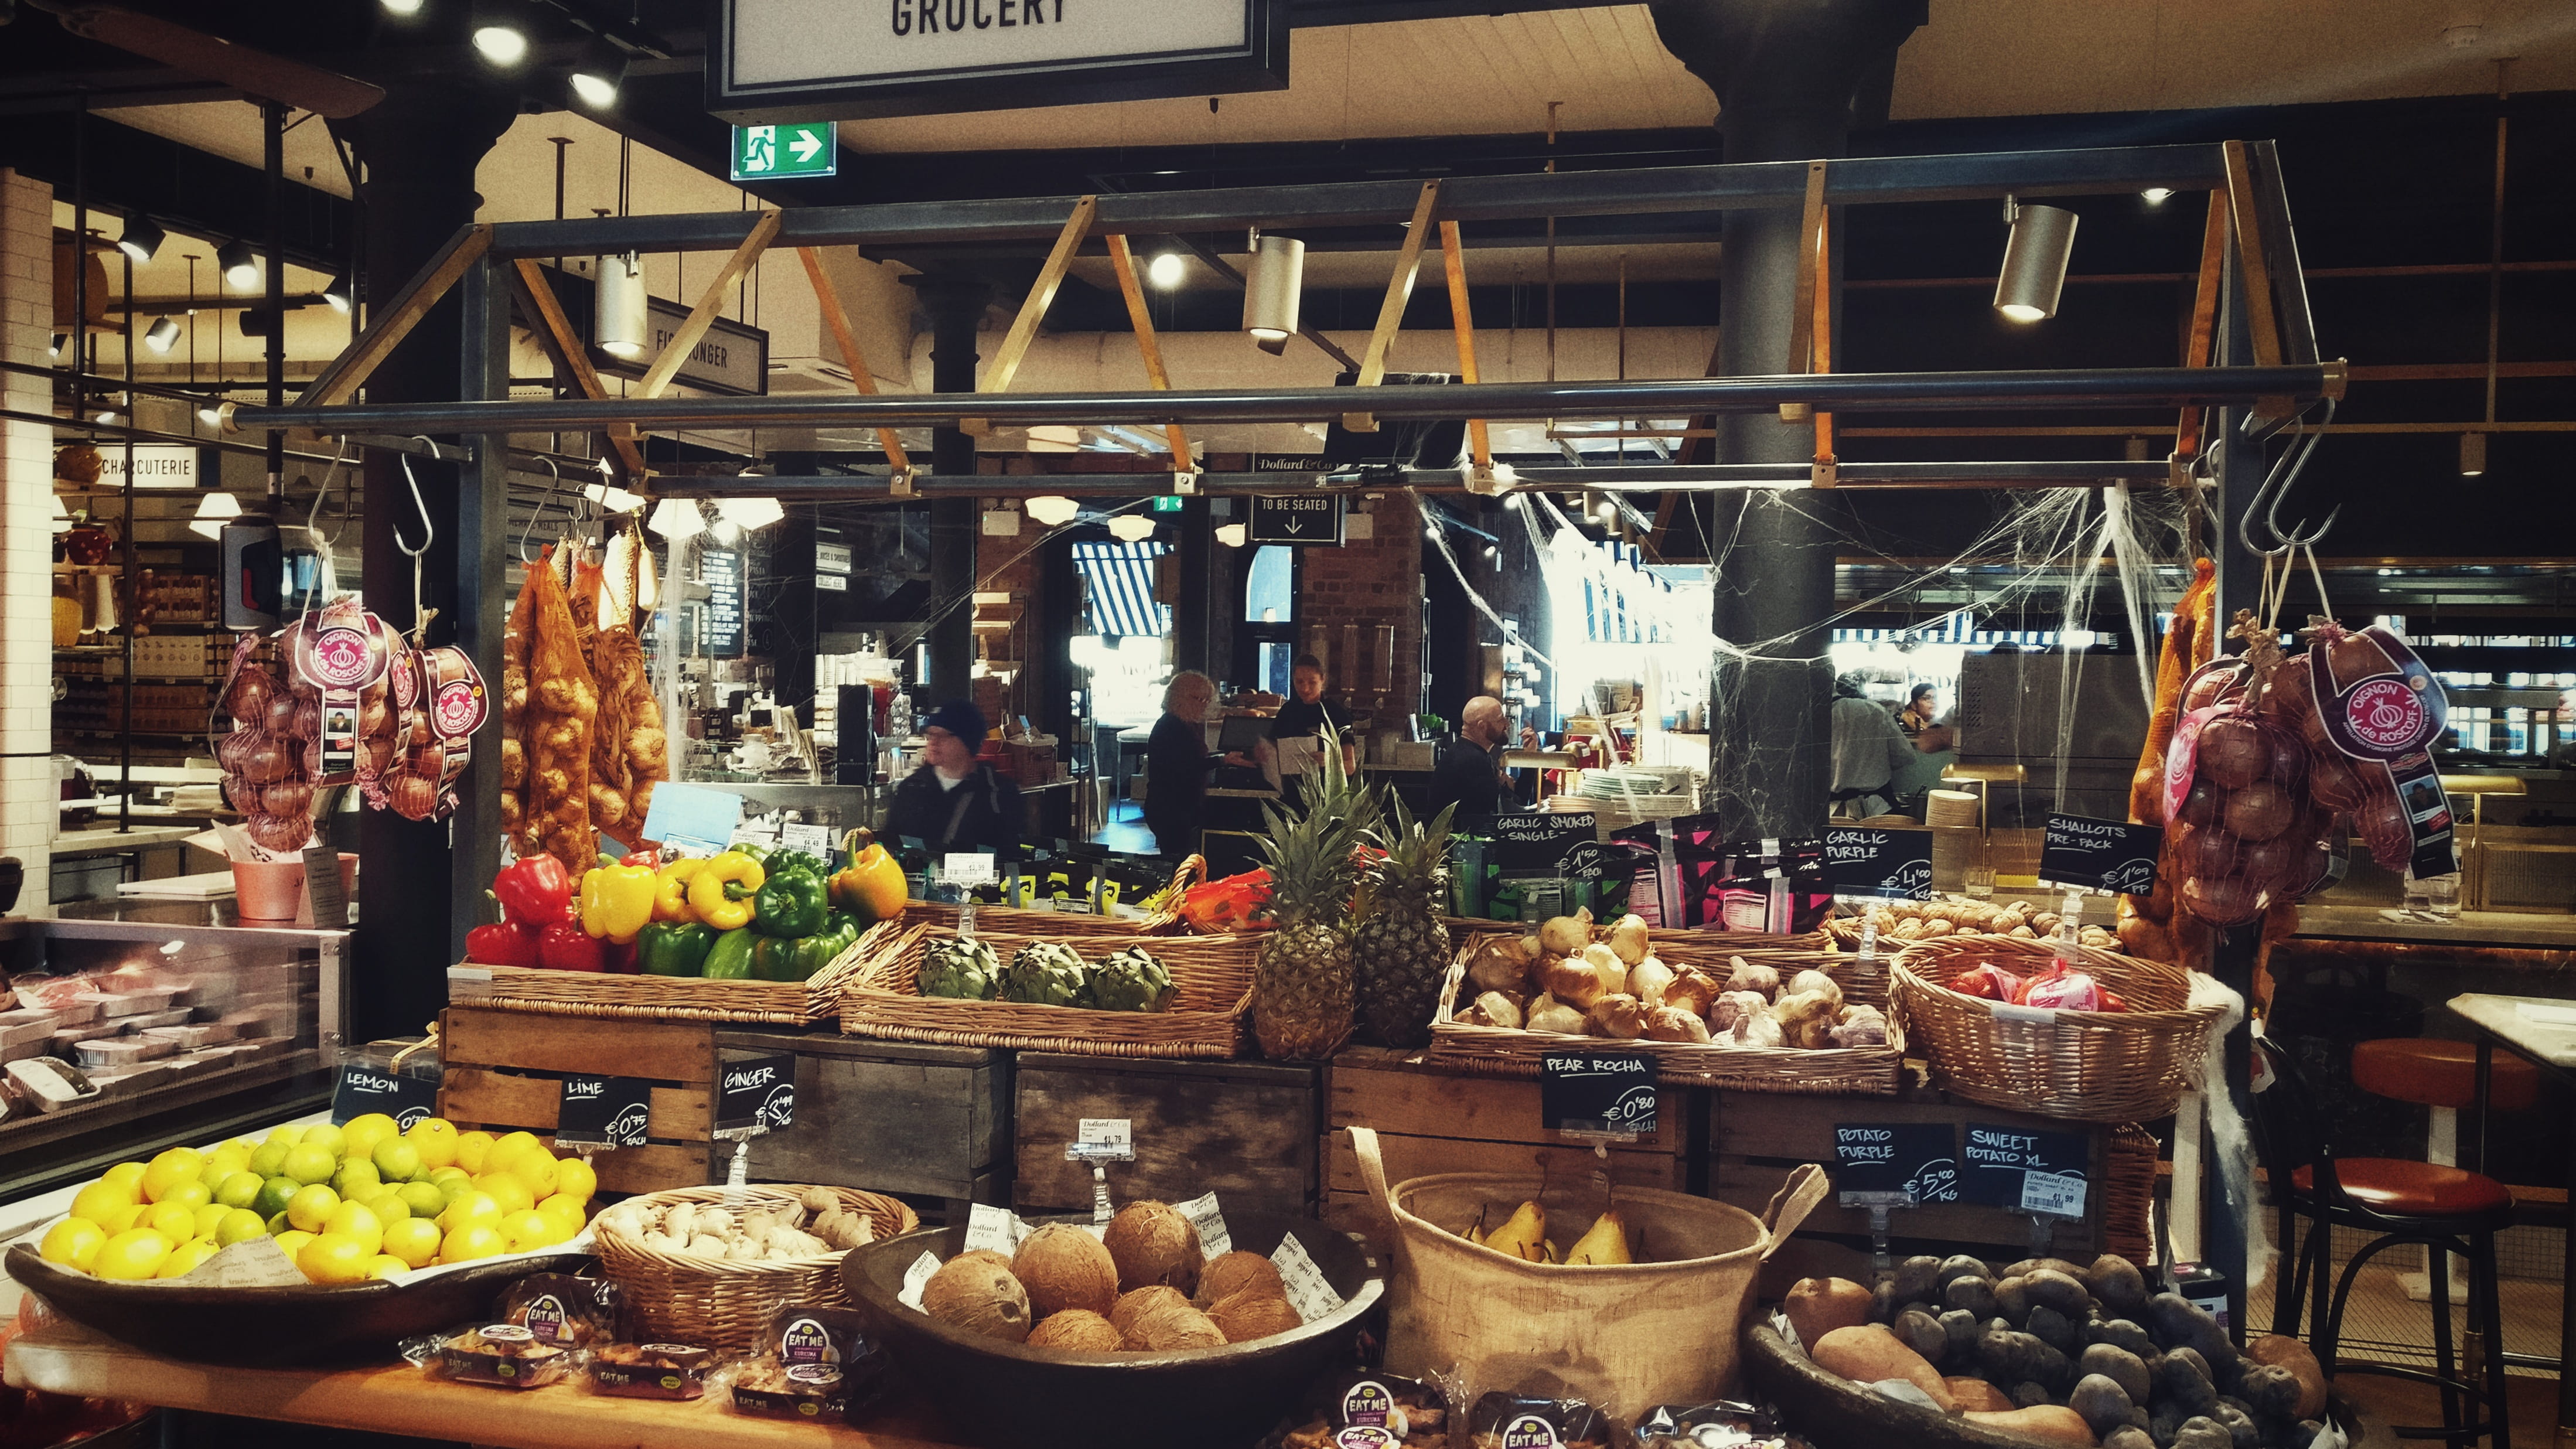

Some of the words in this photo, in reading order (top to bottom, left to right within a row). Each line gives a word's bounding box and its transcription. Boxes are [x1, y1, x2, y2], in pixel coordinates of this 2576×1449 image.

[102, 459, 190, 475] CHACUTERIE
[1258, 458, 1306, 469] Dollard
[1262, 499, 1273, 510] TO
[1277, 499, 1289, 510] BE
[1292, 499, 1327, 511] SEATED
[324, 632, 361, 647] OIGNON
[328, 659, 366, 678] ROSCOFF
[442, 686, 468, 700] OIGNON
[2352, 683, 2398, 708] OIGNON
[2361, 727, 2377, 739] de
[2379, 710, 2418, 742] ROSCOFF
[1497, 817, 1541, 830] GARLIC
[1550, 814, 1595, 829] SMOKED
[2049, 818, 2127, 838] SHALLOTS
[1826, 830, 1889, 844] GARLIC
[1825, 846, 1878, 859] PURPLE
[1582, 867, 1602, 878] EACH
[1915, 889, 1931, 901] KG
[2131, 885, 2149, 894] PP
[1547, 1058, 1585, 1072] PEAR
[1592, 1059, 1646, 1072] ROCHA
[347, 1072, 399, 1093] LEMON
[724, 1066, 776, 1089] GINGER
[568, 1078, 605, 1095] LIME
[1629, 1120, 1656, 1133] EACH
[626, 1136, 647, 1146] EACH
[1837, 1128, 1892, 1142] POTATO
[1971, 1129, 2039, 1151] SWEET
[1837, 1145, 1895, 1159] PURPLE
[1966, 1146, 2020, 1162] POTATO
[2025, 1153, 2049, 1167] XL
[2030, 1173, 2063, 1184] Dollard
[1191, 1192, 1214, 1209] Dollar
[1939, 1189, 1958, 1202] KG
[1193, 1211, 1220, 1227] Dollar
[969, 1223, 998, 1232] Dollard
[1200, 1230, 1228, 1247] Dollar
[910, 1252, 930, 1276] Dollar
[530, 1308, 548, 1321] EAT
[548, 1311, 561, 1322] ME
[788, 1334, 808, 1346] EAT
[808, 1335, 824, 1346] ME
[601, 1372, 617, 1382] EAT
[617, 1374, 630, 1382] ME
[1349, 1399, 1370, 1412] EAT
[1371, 1397, 1387, 1411] ME
[1345, 1431, 1369, 1441] EAT
[1509, 1434, 1531, 1448] EAT
[1532, 1432, 1548, 1446] ME
